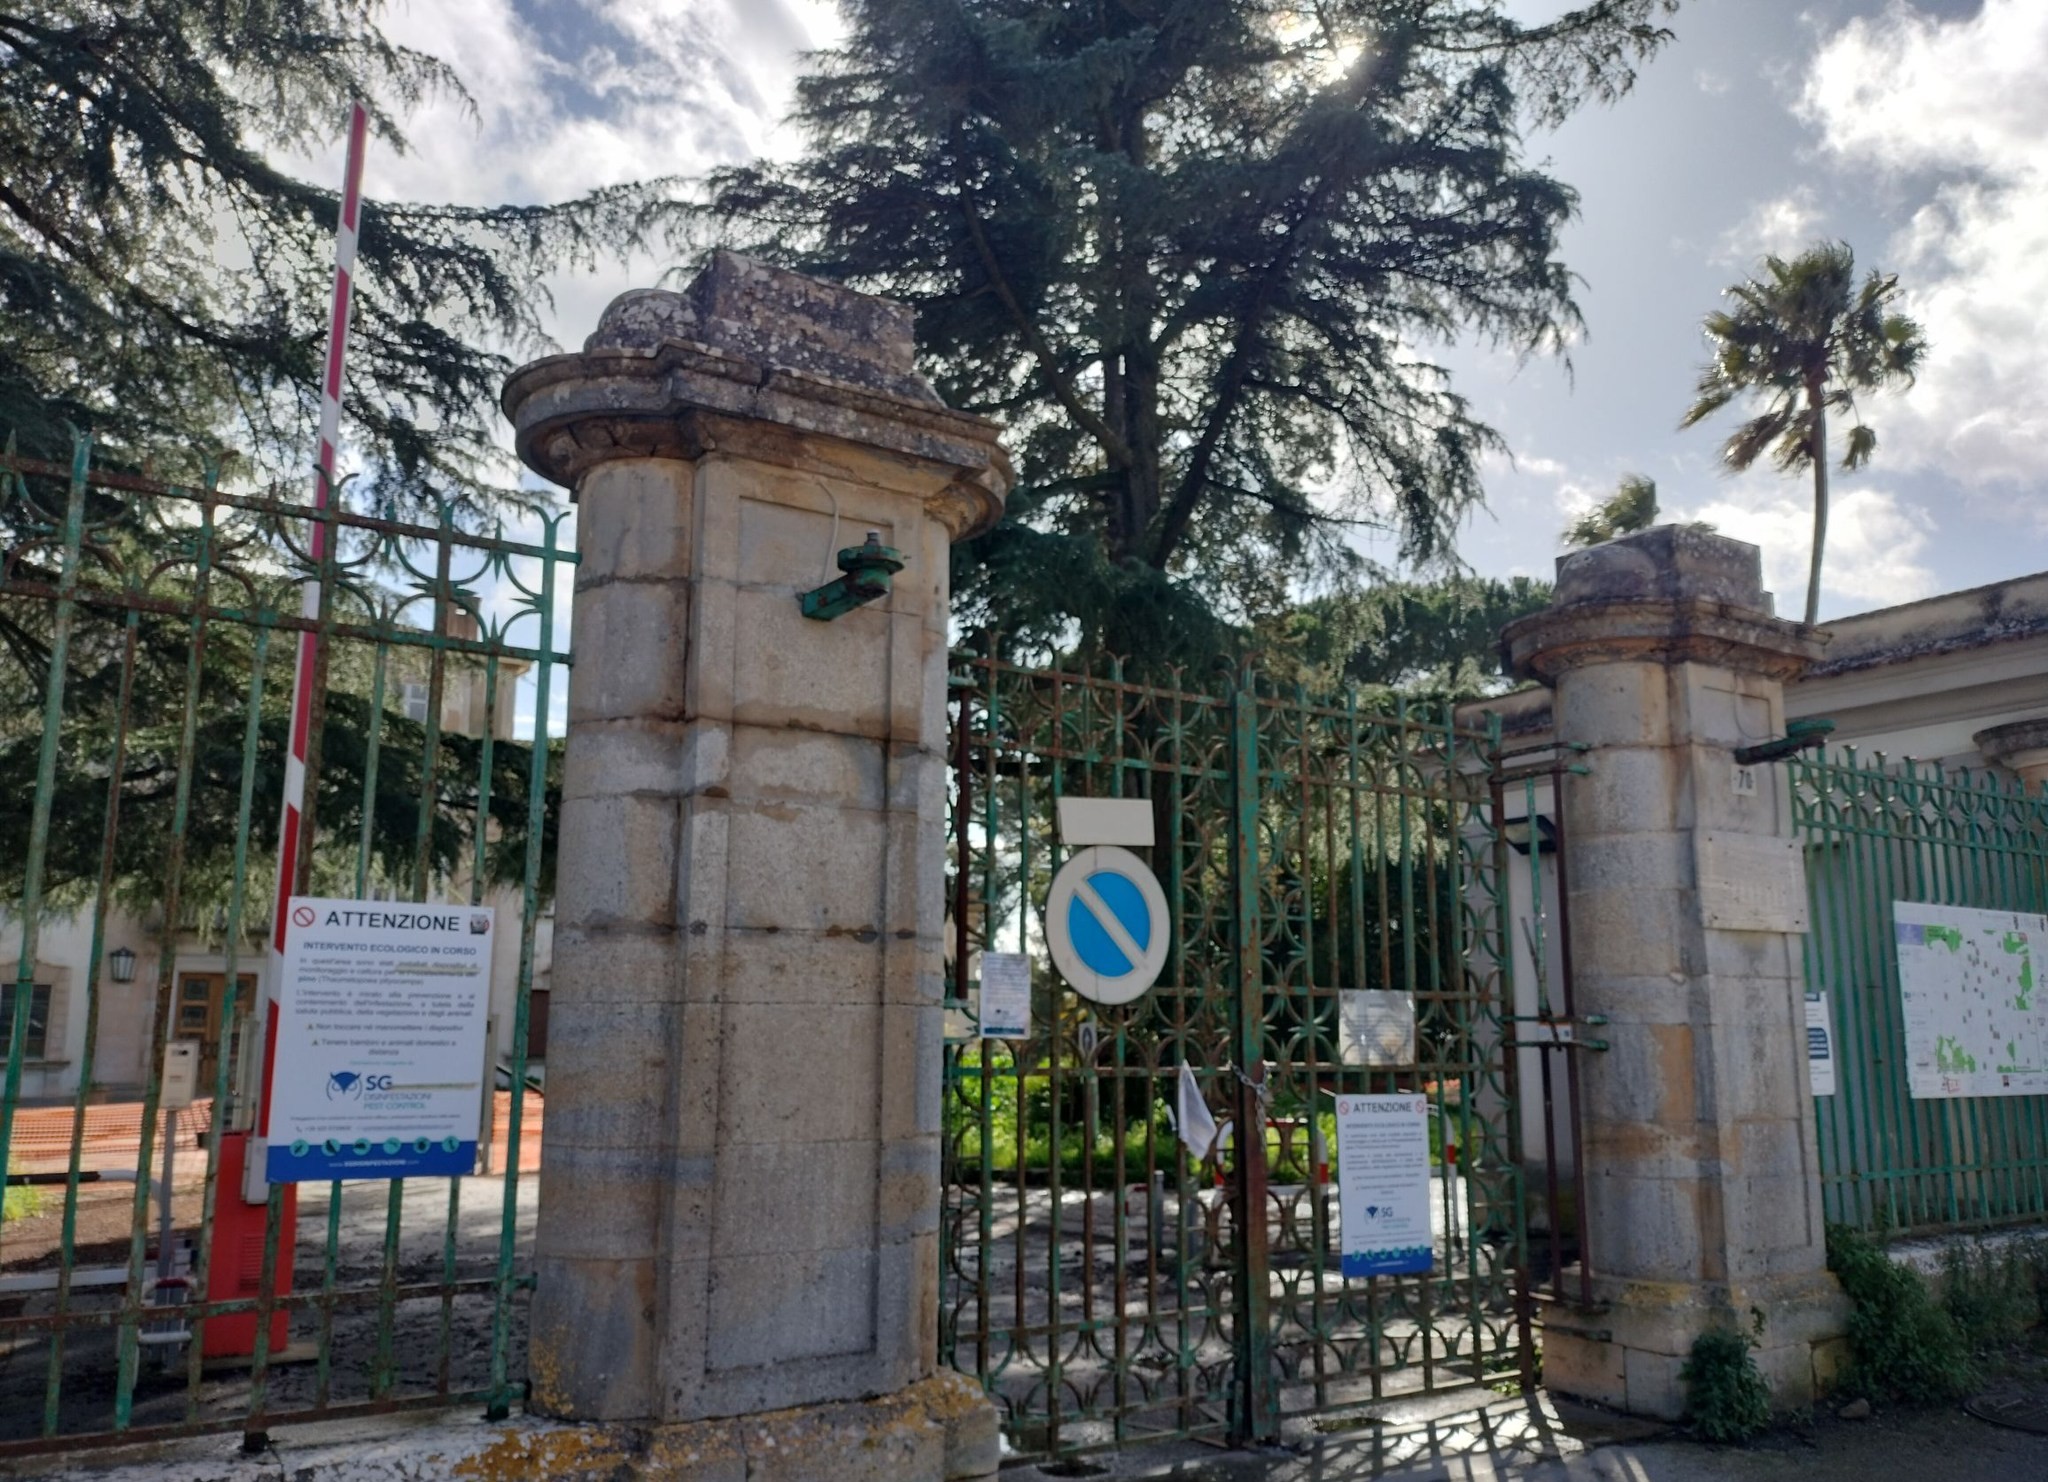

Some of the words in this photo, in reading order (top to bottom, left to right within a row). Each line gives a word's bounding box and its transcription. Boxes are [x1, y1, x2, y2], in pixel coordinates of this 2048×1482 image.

[325, 911, 461, 932] ATTENZIONE
[303, 942, 367, 952] INTERVENTO
[369, 944, 429, 954] ECOLOGICO
[430, 946, 440, 955] IN
[442, 946, 477, 956] CORSO
[366, 1075, 393, 1091] SG
[1353, 1102, 1412, 1113] ATTENZIONE
